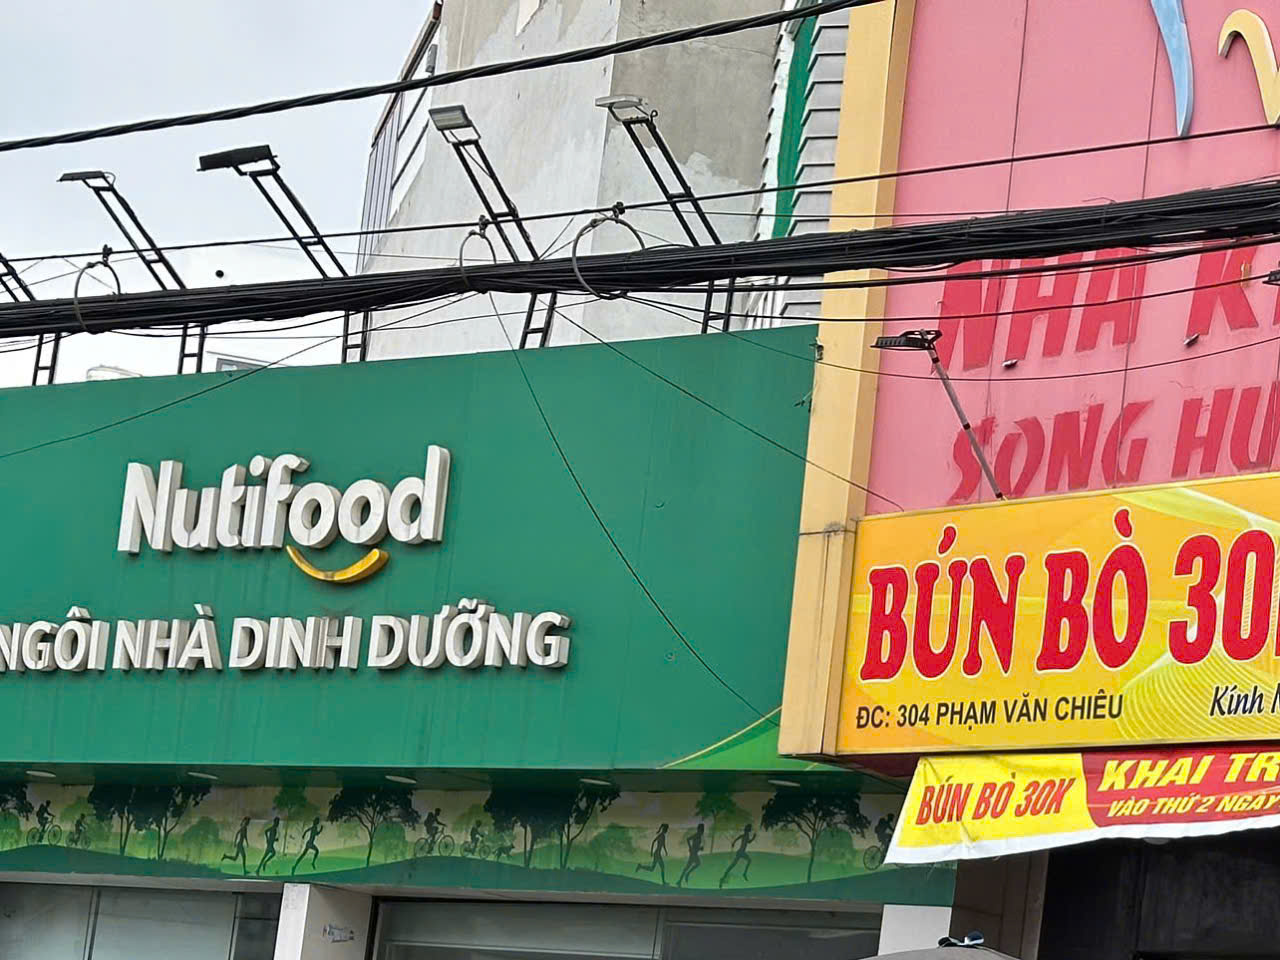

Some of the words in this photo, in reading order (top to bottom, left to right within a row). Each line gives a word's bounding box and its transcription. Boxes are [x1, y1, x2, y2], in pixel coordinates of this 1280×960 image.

[118, 445, 451, 555] Nutifood
[858, 523, 1027, 682] BÚN
[1035, 506, 1152, 674] BÒ
[0, 605, 110, 672] NGÔI
[112, 603, 222, 671] NHÀ
[229, 614, 363, 671] DINH
[367, 598, 573, 671] DƯỠNG
[855, 708, 890, 730] ĐC:
[896, 706, 930, 727] 304
[935, 701, 997, 731] PHẠM
[1000, 694, 1049, 725] VĂN
[1051, 692, 1125, 721] CHIÊU
[1209, 683, 1265, 718] Kính
[1097, 755, 1216, 792] KHAI
[915, 775, 974, 825] BÚN
[972, 772, 1016, 820] BÒ
[1014, 777, 1077, 817] 30K
[1107, 795, 1150, 818] VÀO
[1154, 791, 1195, 815] THỨ
[1194, 797, 1214, 814] 2
